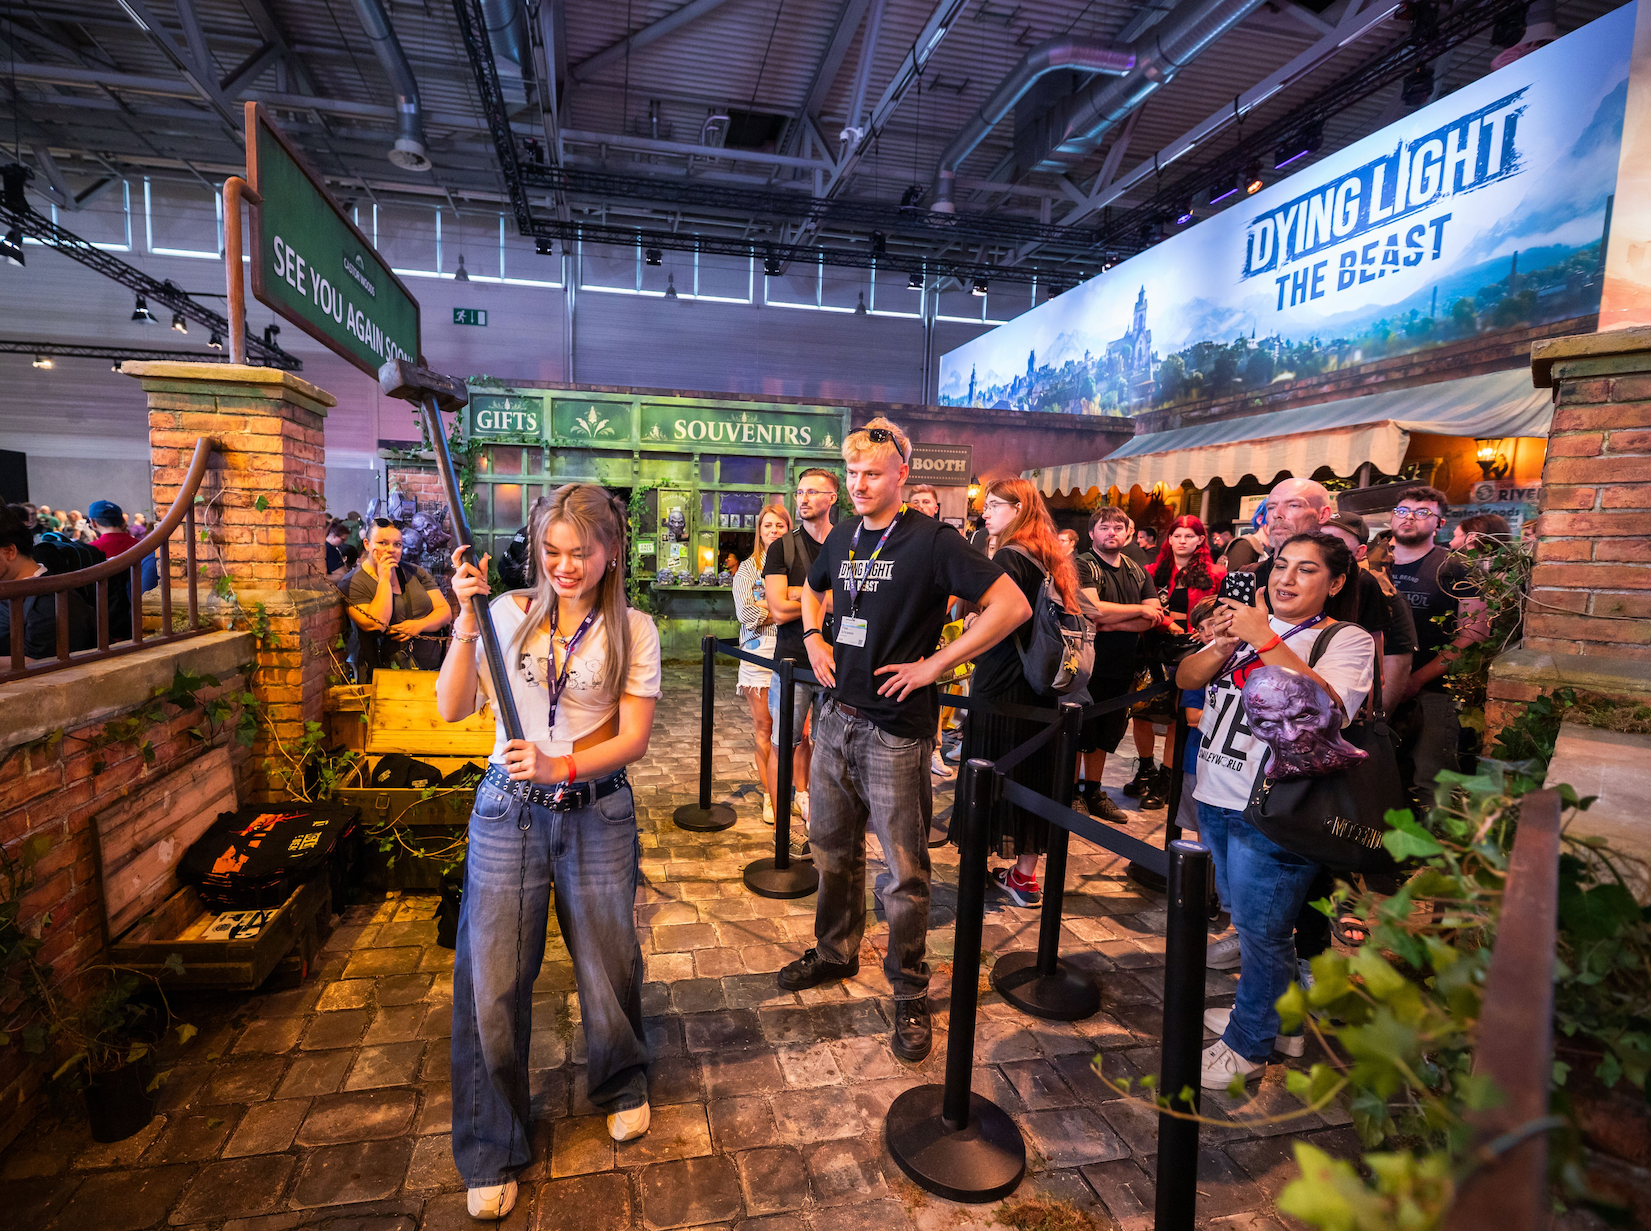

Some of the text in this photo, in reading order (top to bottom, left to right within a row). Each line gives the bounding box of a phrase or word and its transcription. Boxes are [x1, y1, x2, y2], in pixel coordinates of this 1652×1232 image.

[1249, 104, 1521, 272] DYING LIGHT
[1275, 212, 1453, 312] THE BEAST
[273, 235, 307, 297] SEE
[309, 266, 343, 324] YOU
[346, 302, 384, 358] AGAIN
[360, 274, 376, 297] WOODS
[476, 409, 537, 431] GIFTS
[673, 419, 812, 446] SOUVENIRS
[911, 457, 967, 472] BOOTH
